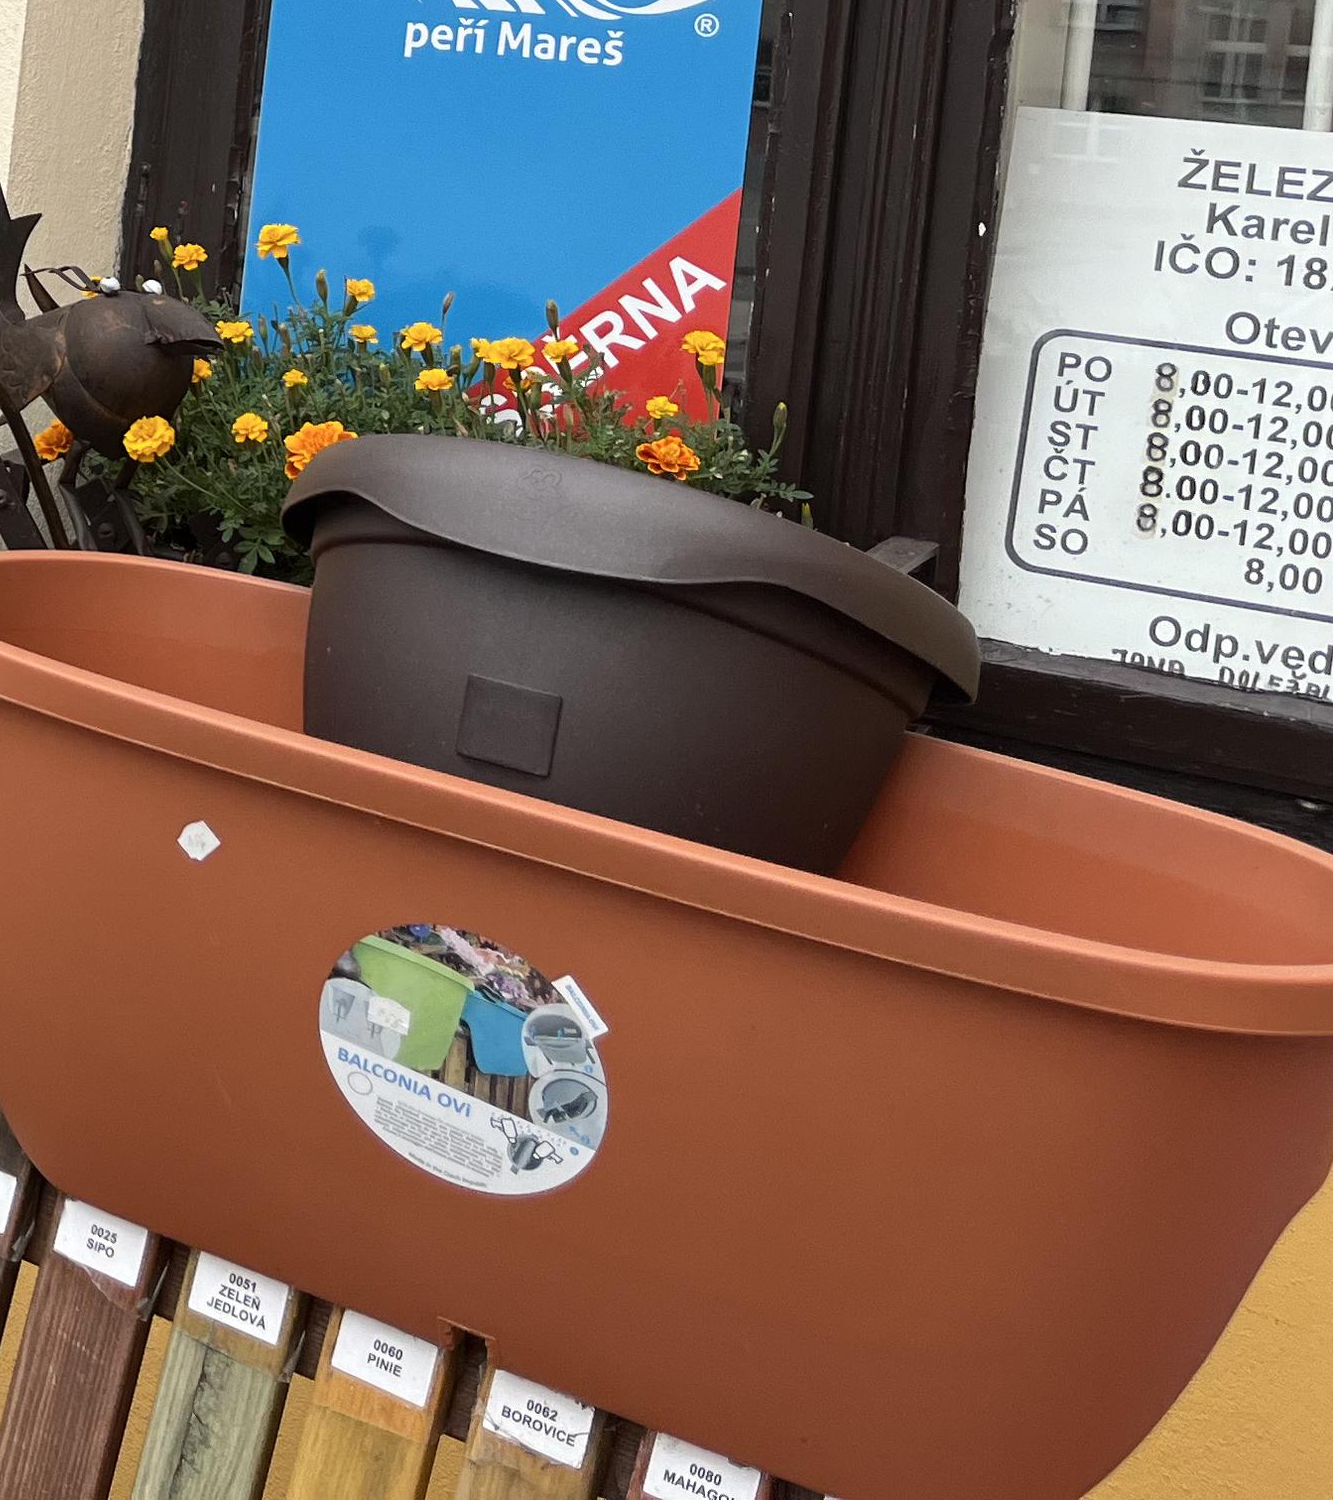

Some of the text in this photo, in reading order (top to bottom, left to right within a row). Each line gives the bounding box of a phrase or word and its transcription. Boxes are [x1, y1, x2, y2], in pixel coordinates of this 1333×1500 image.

[404, 17, 625, 66] peří Mareš
[1177, 148, 1333, 203] ŽELEZ
[1206, 202, 1330, 247] Karel
[1154, 233, 1333, 293] IČO: 18
[1226, 311, 1333, 354] Otev
[1053, 380, 1106, 416] ÚT
[1057, 351, 1333, 413] PO 8,00-12,0
[1047, 420, 1098, 450] ST
[1043, 447, 1096, 485] ČT
[1038, 487, 1090, 522] PÁ
[1033, 523, 1323, 594] SO 8,00
[337, 1046, 432, 1101] BALCONIA
[86, 1237, 115, 1259] SIPO
[91, 1224, 117, 1245] 0025
[219, 1284, 261, 1311] ZELEŇ
[229, 1272, 257, 1293] 0051
[206, 1296, 266, 1331] JEDLOVÁ
[366, 1352, 403, 1378] PINIE
[373, 1338, 404, 1362] 0060
[500, 1405, 576, 1448] BOROVICE
[526, 1399, 559, 1423] 0062
[689, 1463, 723, 1486] 0080
